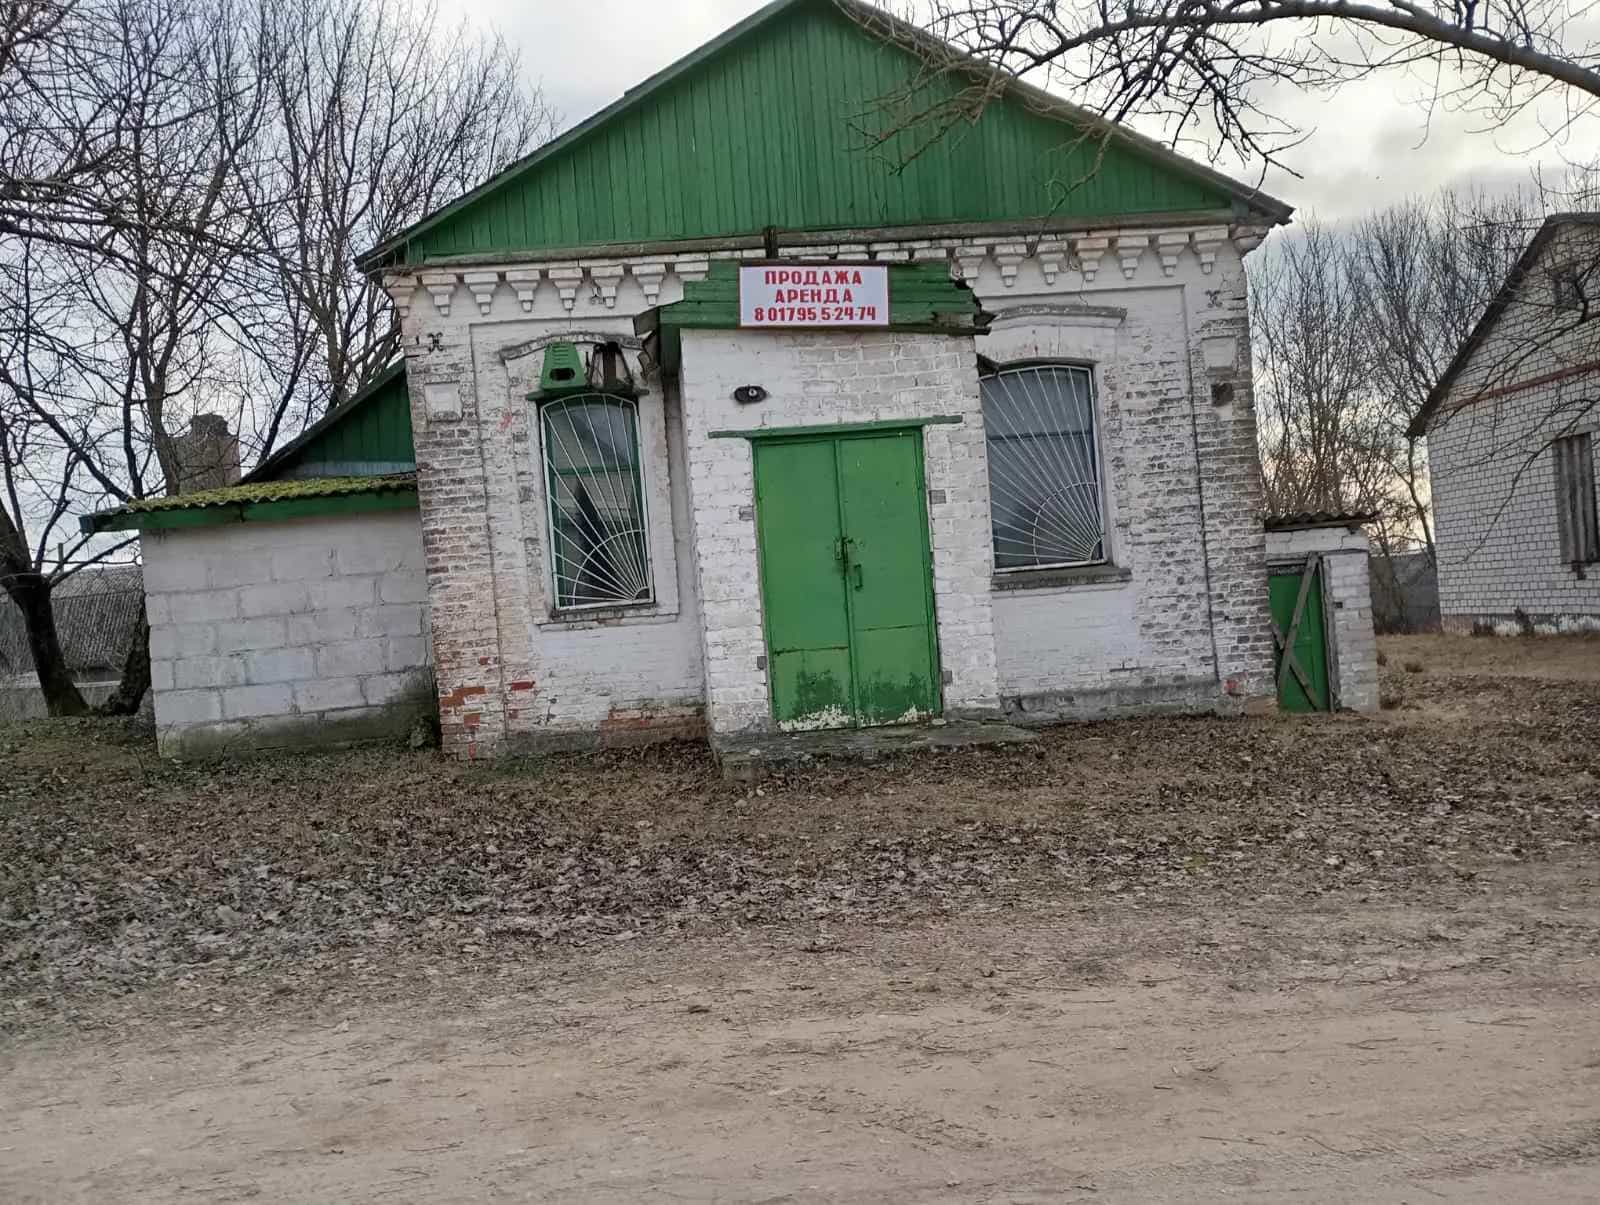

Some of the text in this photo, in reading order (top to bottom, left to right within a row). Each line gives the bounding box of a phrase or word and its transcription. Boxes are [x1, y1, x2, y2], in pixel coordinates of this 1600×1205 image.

[765, 271, 862, 285] ПРОДАЖА
[775, 289, 853, 304] АРЕНДА
[754, 307, 764, 321] 8
[768, 307, 817, 321] 01795
